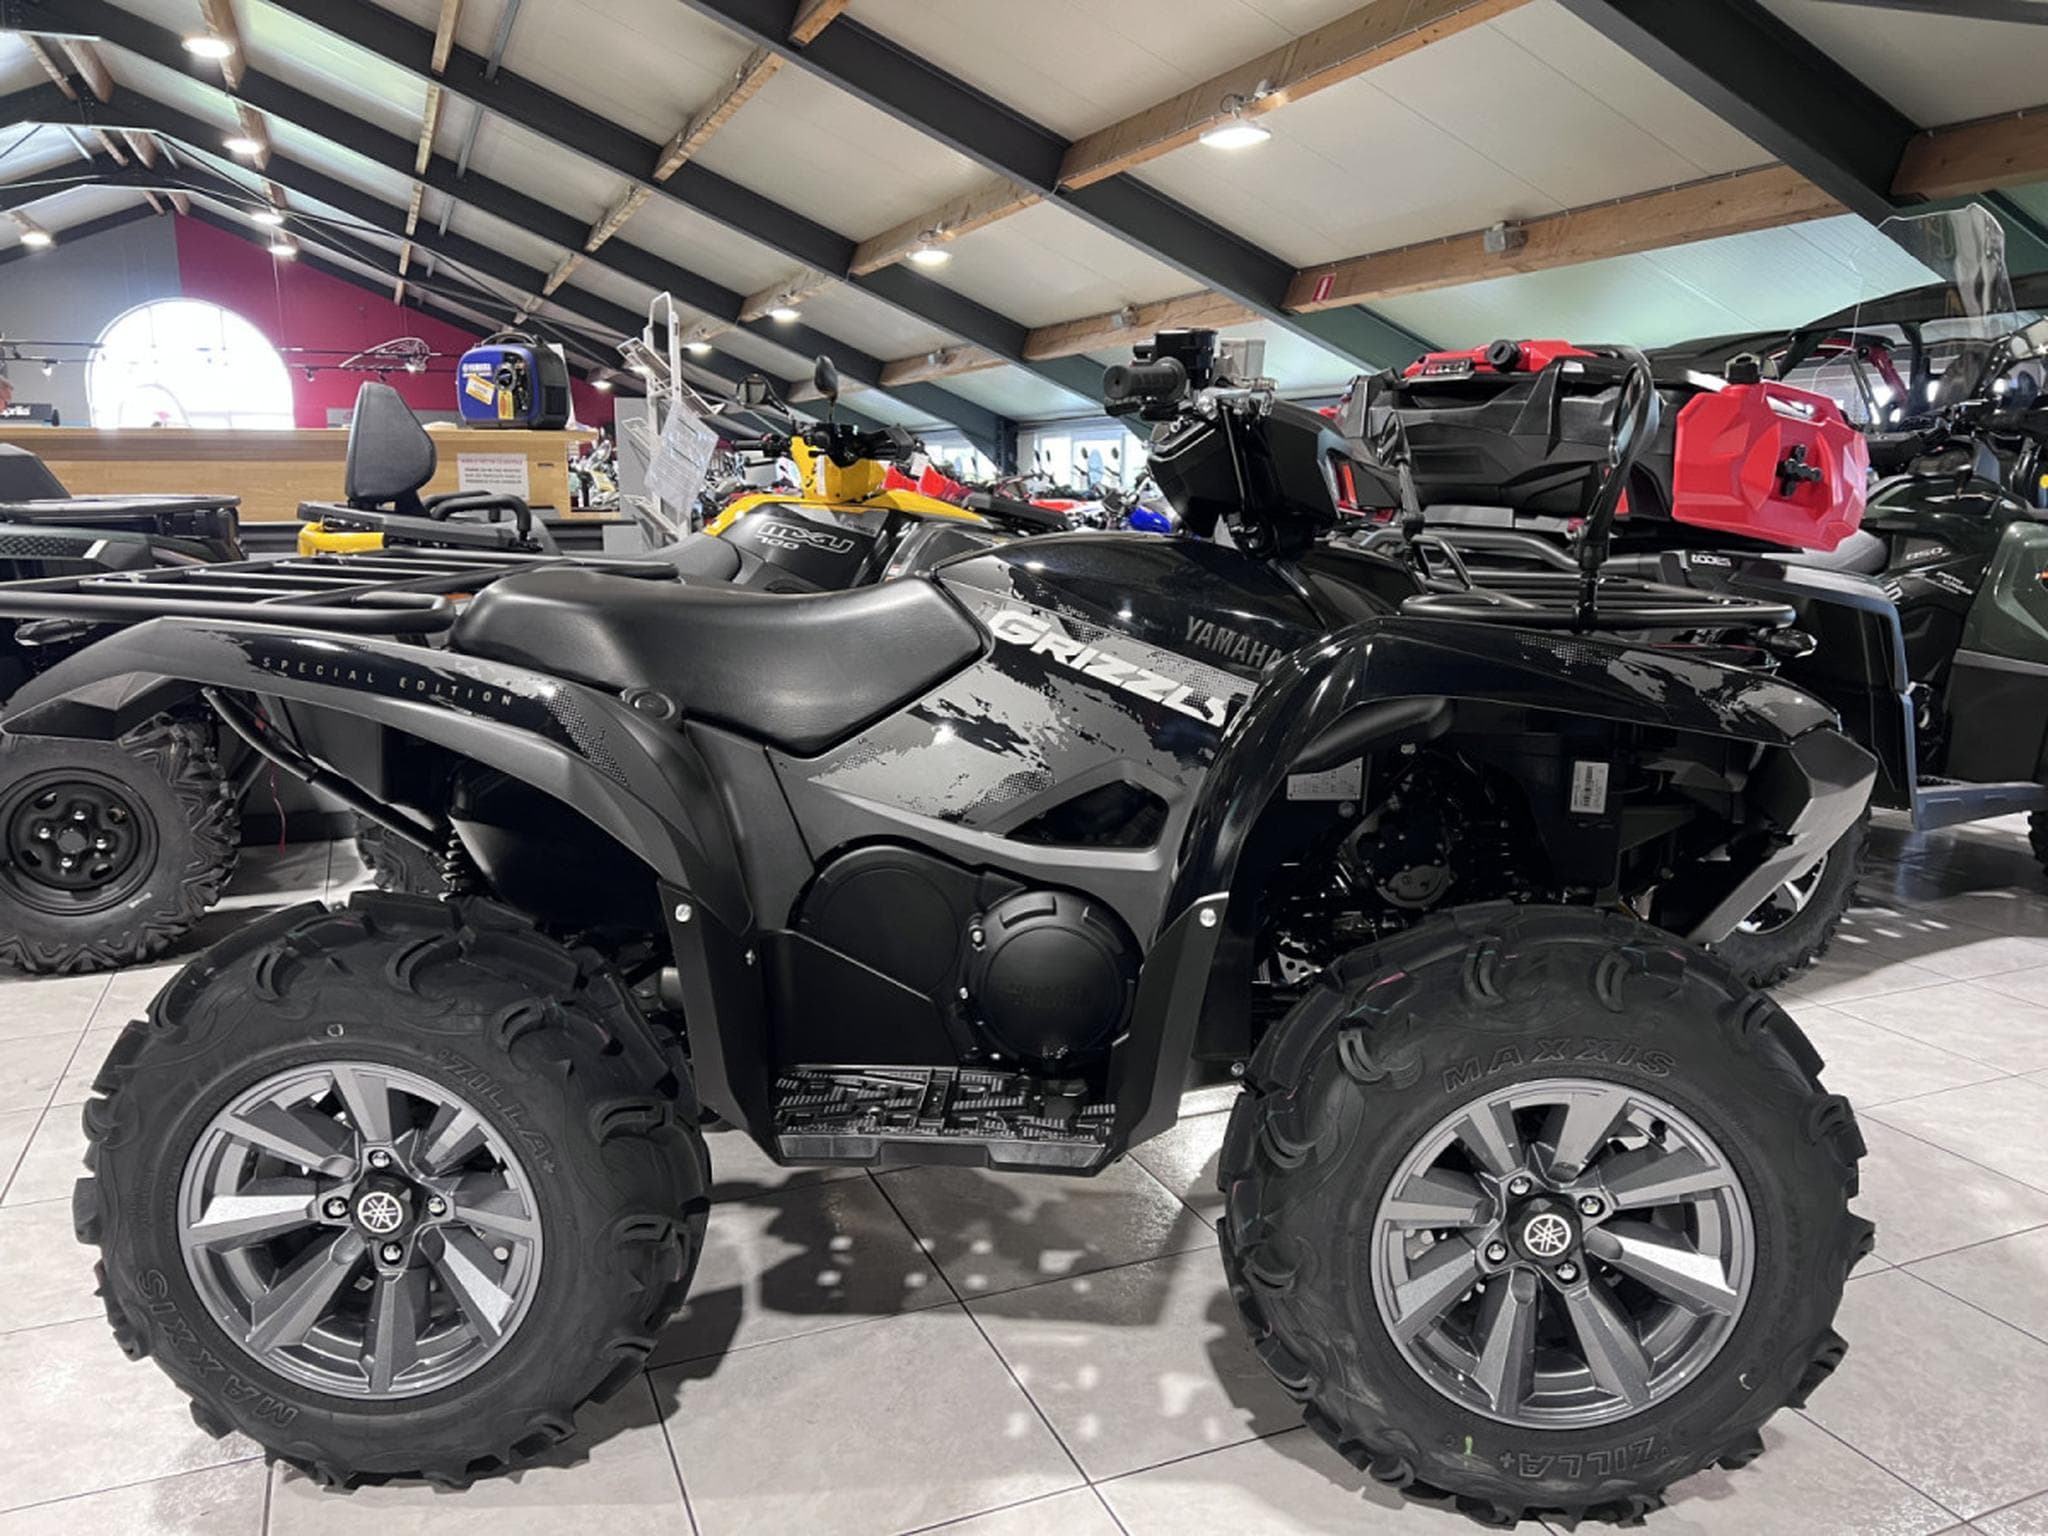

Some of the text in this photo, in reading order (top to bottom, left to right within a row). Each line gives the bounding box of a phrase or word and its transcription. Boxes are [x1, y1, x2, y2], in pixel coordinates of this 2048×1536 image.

[1185, 615, 1282, 671] YAMAHA
[263, 657, 511, 706] SPECIAL EDITION
[1443, 1038, 1676, 1093] MAXXIS
[135, 1269, 299, 1428] MAXXIS
